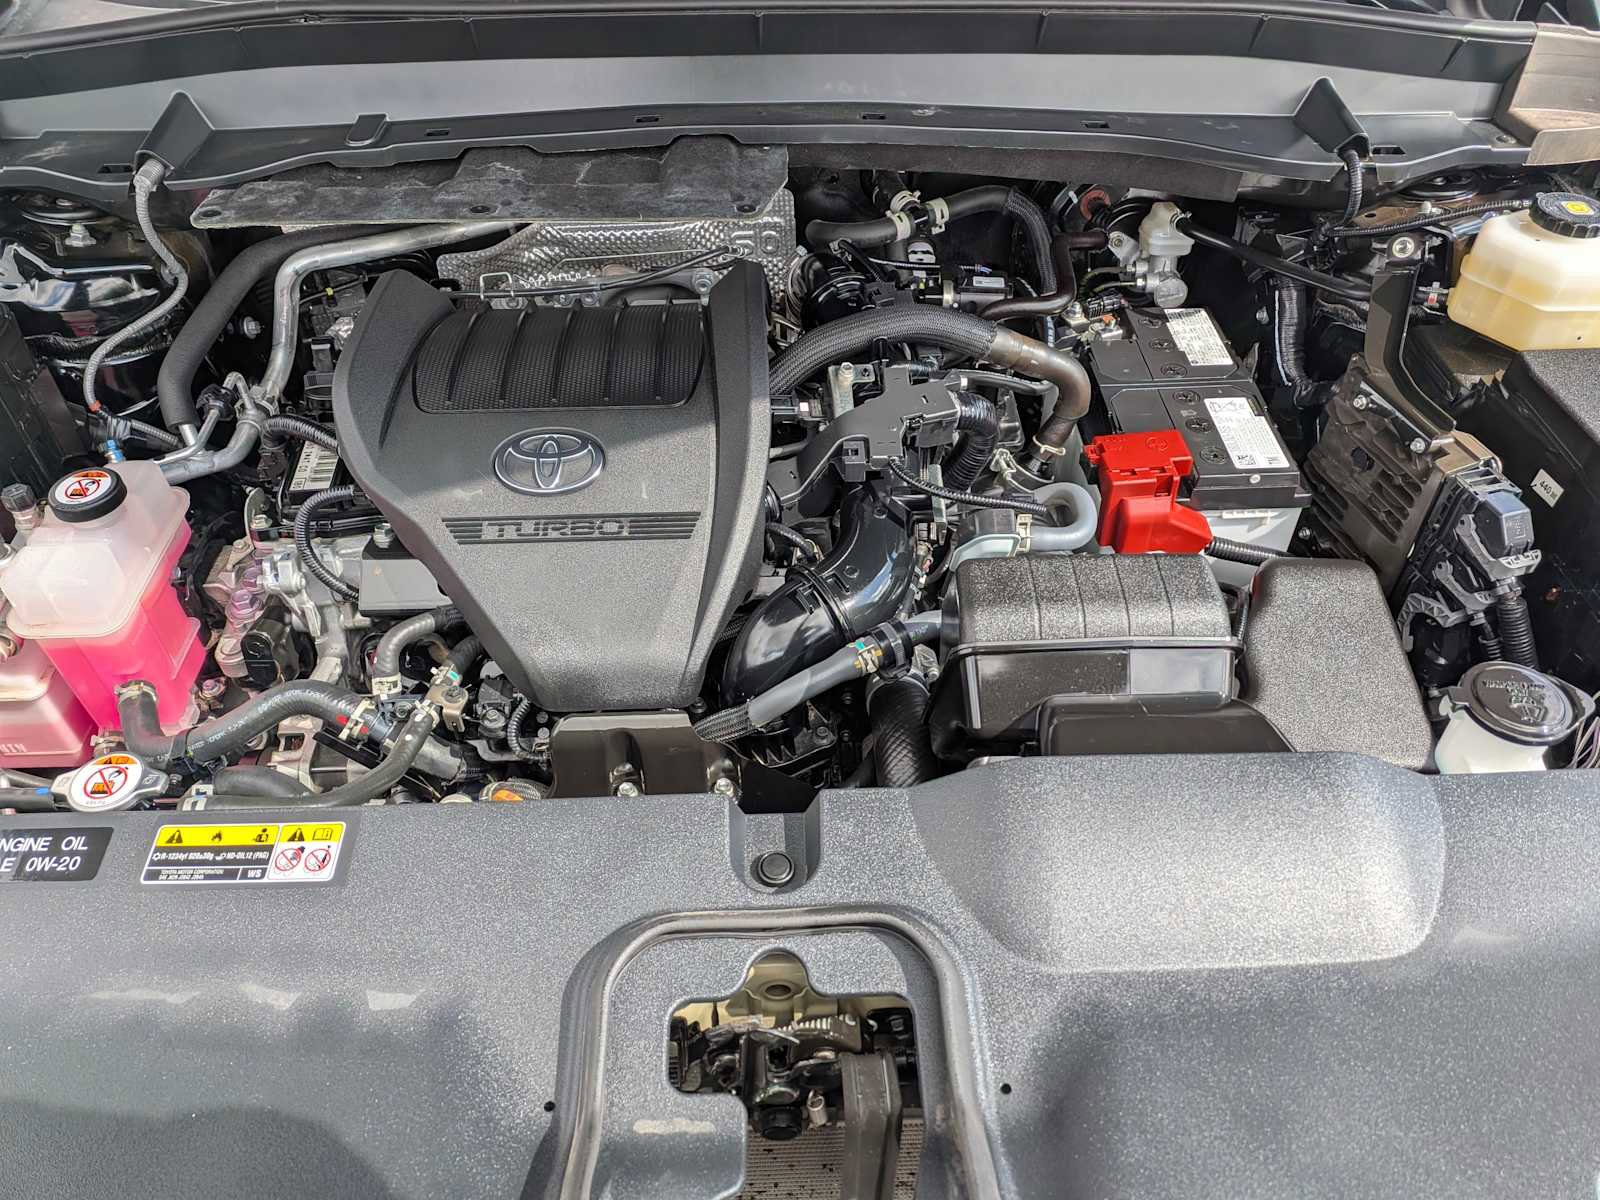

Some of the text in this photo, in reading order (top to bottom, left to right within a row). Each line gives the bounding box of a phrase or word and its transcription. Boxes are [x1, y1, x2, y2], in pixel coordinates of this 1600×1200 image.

[486, 519, 625, 538] TURBO
[61, 836, 88, 851] OIL
[25, 856, 81, 872] 0W-20
[247, 869, 262, 878] WS
